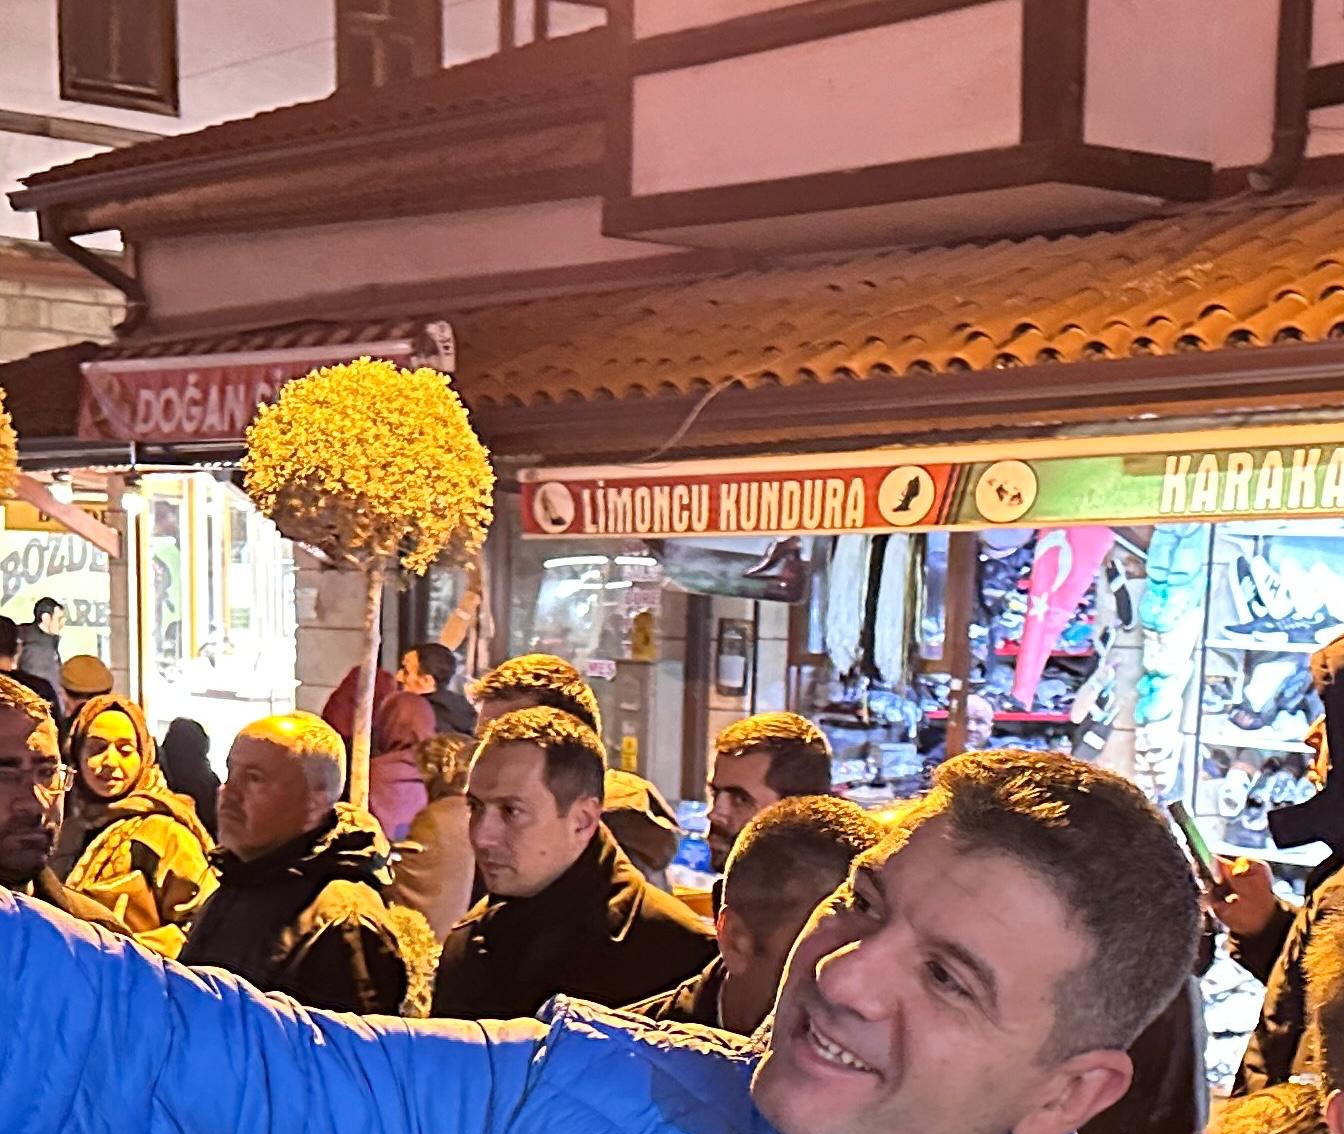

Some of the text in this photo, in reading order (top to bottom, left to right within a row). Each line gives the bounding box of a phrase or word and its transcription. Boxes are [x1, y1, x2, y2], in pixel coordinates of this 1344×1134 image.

[134, 373, 248, 435] DOĞAN
[582, 477, 866, 533] LİMONCU KUNDURA
